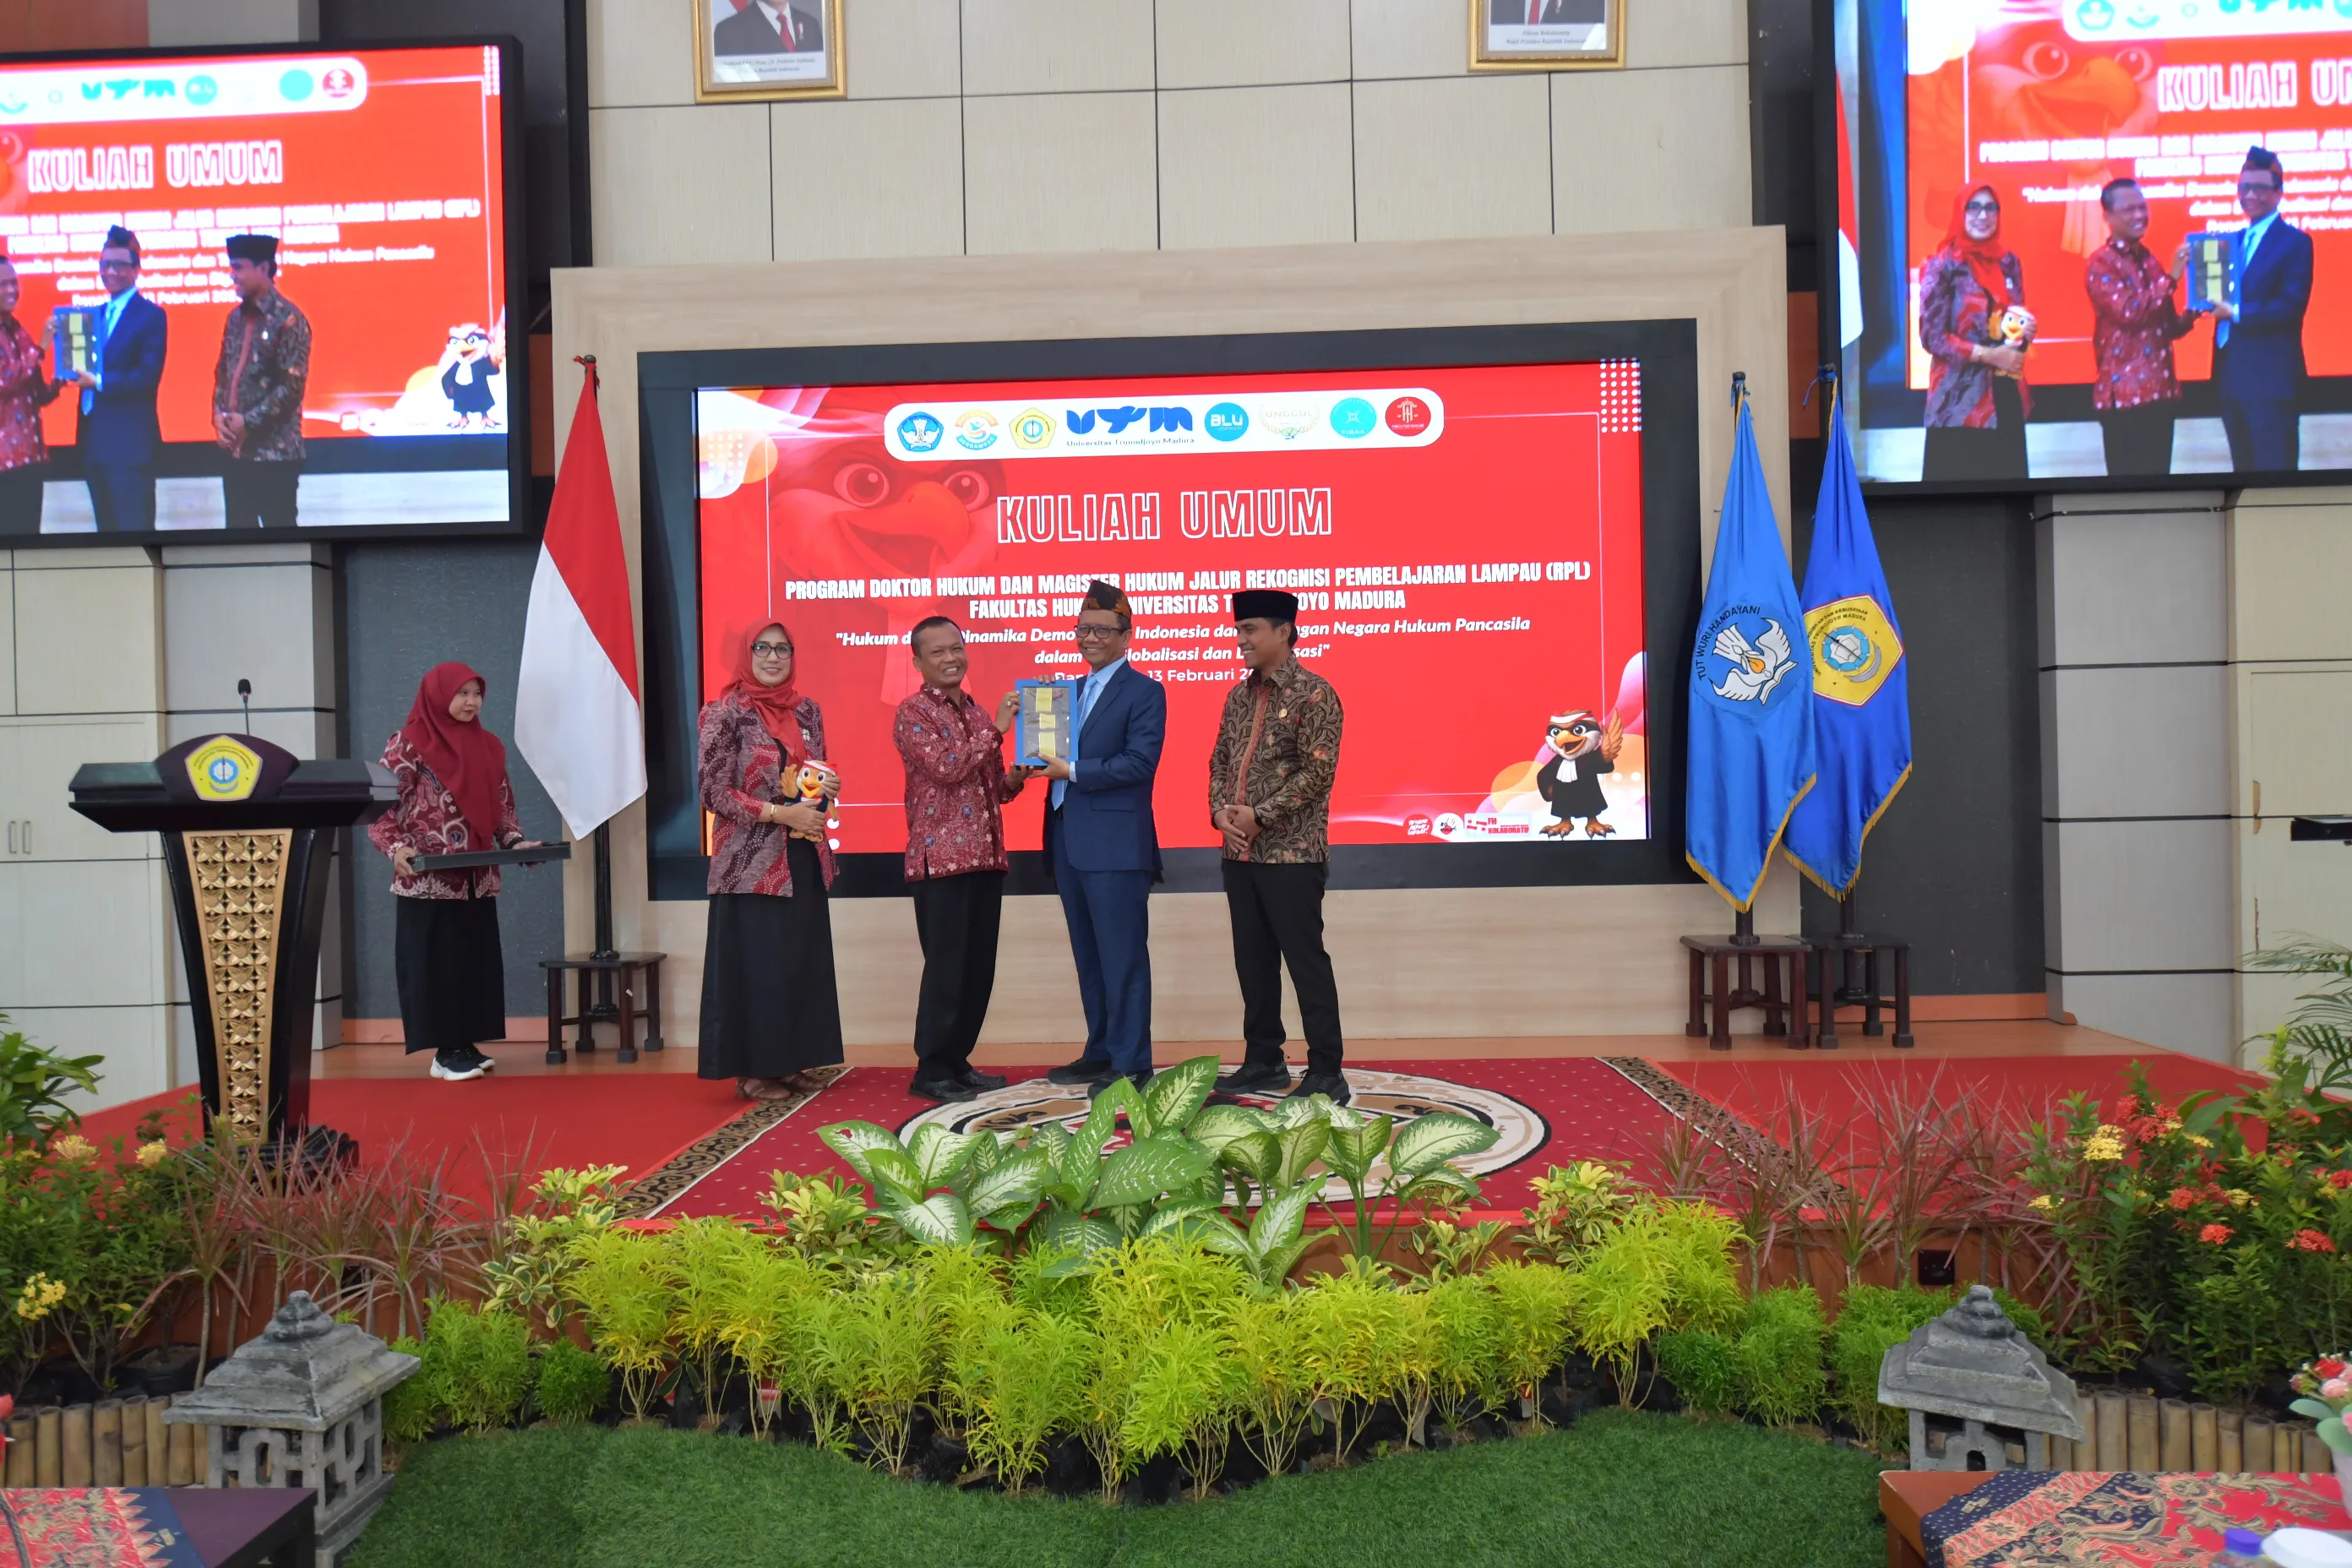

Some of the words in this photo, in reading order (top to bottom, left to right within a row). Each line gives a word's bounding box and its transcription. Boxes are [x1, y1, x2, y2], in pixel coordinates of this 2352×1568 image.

[2158, 61, 2298, 112] KULIAH
[27, 145, 155, 193] KULIAH
[166, 139, 283, 188] UMUM
[1210, 412, 1244, 427] BLU
[997, 493, 1161, 544] KULIAH
[1180, 487, 1332, 539] UMUM
[785, 580, 865, 600] PROGRAM
[869, 578, 932, 598] DOKTOR
[936, 576, 995, 596] HUKUM
[1000, 575, 1033, 595] DAN
[1124, 572, 1184, 591] HUKUM
[1189, 570, 1241, 590] JALUR
[1245, 568, 1331, 589] REKOGNISI
[1335, 564, 1467, 586] PEMBELAJARAN
[1471, 563, 1541, 583] LAMPAU
[1546, 561, 1591, 580] (RPL)
[969, 598, 1048, 619] FAKULTAS
[1127, 594, 1219, 615] NIVERSITAS
[1334, 590, 1406, 610] MADURA
[836, 632, 898, 646] "Hukum
[1135, 623, 1211, 640] Indonesia
[1333, 621, 1391, 637] Negara
[1393, 618, 1451, 634] Hukum
[1455, 617, 1531, 632] Pancasila
[1707, 605, 1761, 634] HANDAYANI
[1034, 650, 1083, 664] dalam
[1124, 645, 1198, 662] lobalisasi
[1202, 645, 1233, 660] dan
[1696, 631, 1712, 657] WURI
[1147, 670, 1163, 683] 13
[1168, 667, 1234, 682] Februari
[1696, 660, 1707, 681] TUT
